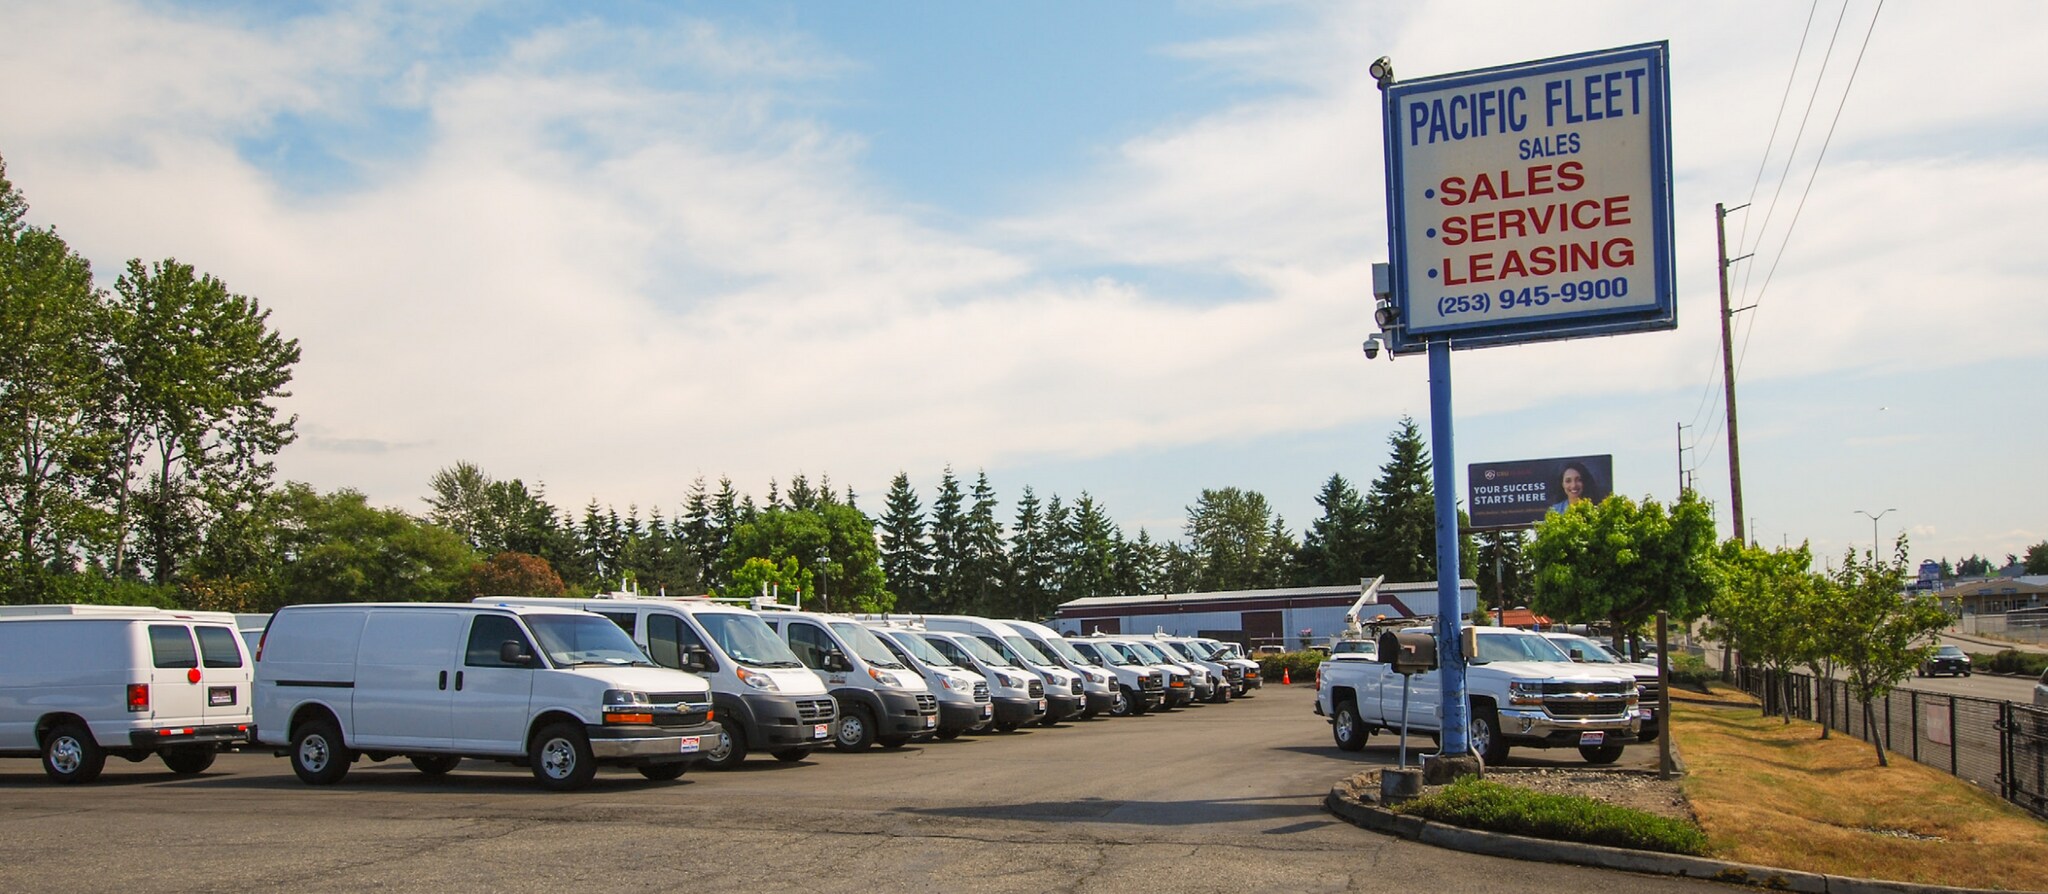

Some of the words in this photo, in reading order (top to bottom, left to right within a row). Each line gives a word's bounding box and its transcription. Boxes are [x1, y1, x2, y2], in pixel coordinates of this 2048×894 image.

[1410, 86, 1527, 146] PACIFIC
[1545, 68, 1646, 127] FLEET
[1519, 132, 1581, 160] SALES
[1440, 161, 1585, 206] SALES
[1442, 195, 1631, 246] SERVICE
[1443, 237, 1635, 286] LEASING
[1437, 292, 1491, 317] (253)
[1499, 277, 1628, 309] 945-9900
[1474, 485, 1500, 494] YOUR
[1503, 482, 1546, 493] SUCCESS
[1474, 494, 1514, 505] STARTS
[1517, 493, 1546, 502] HERE
